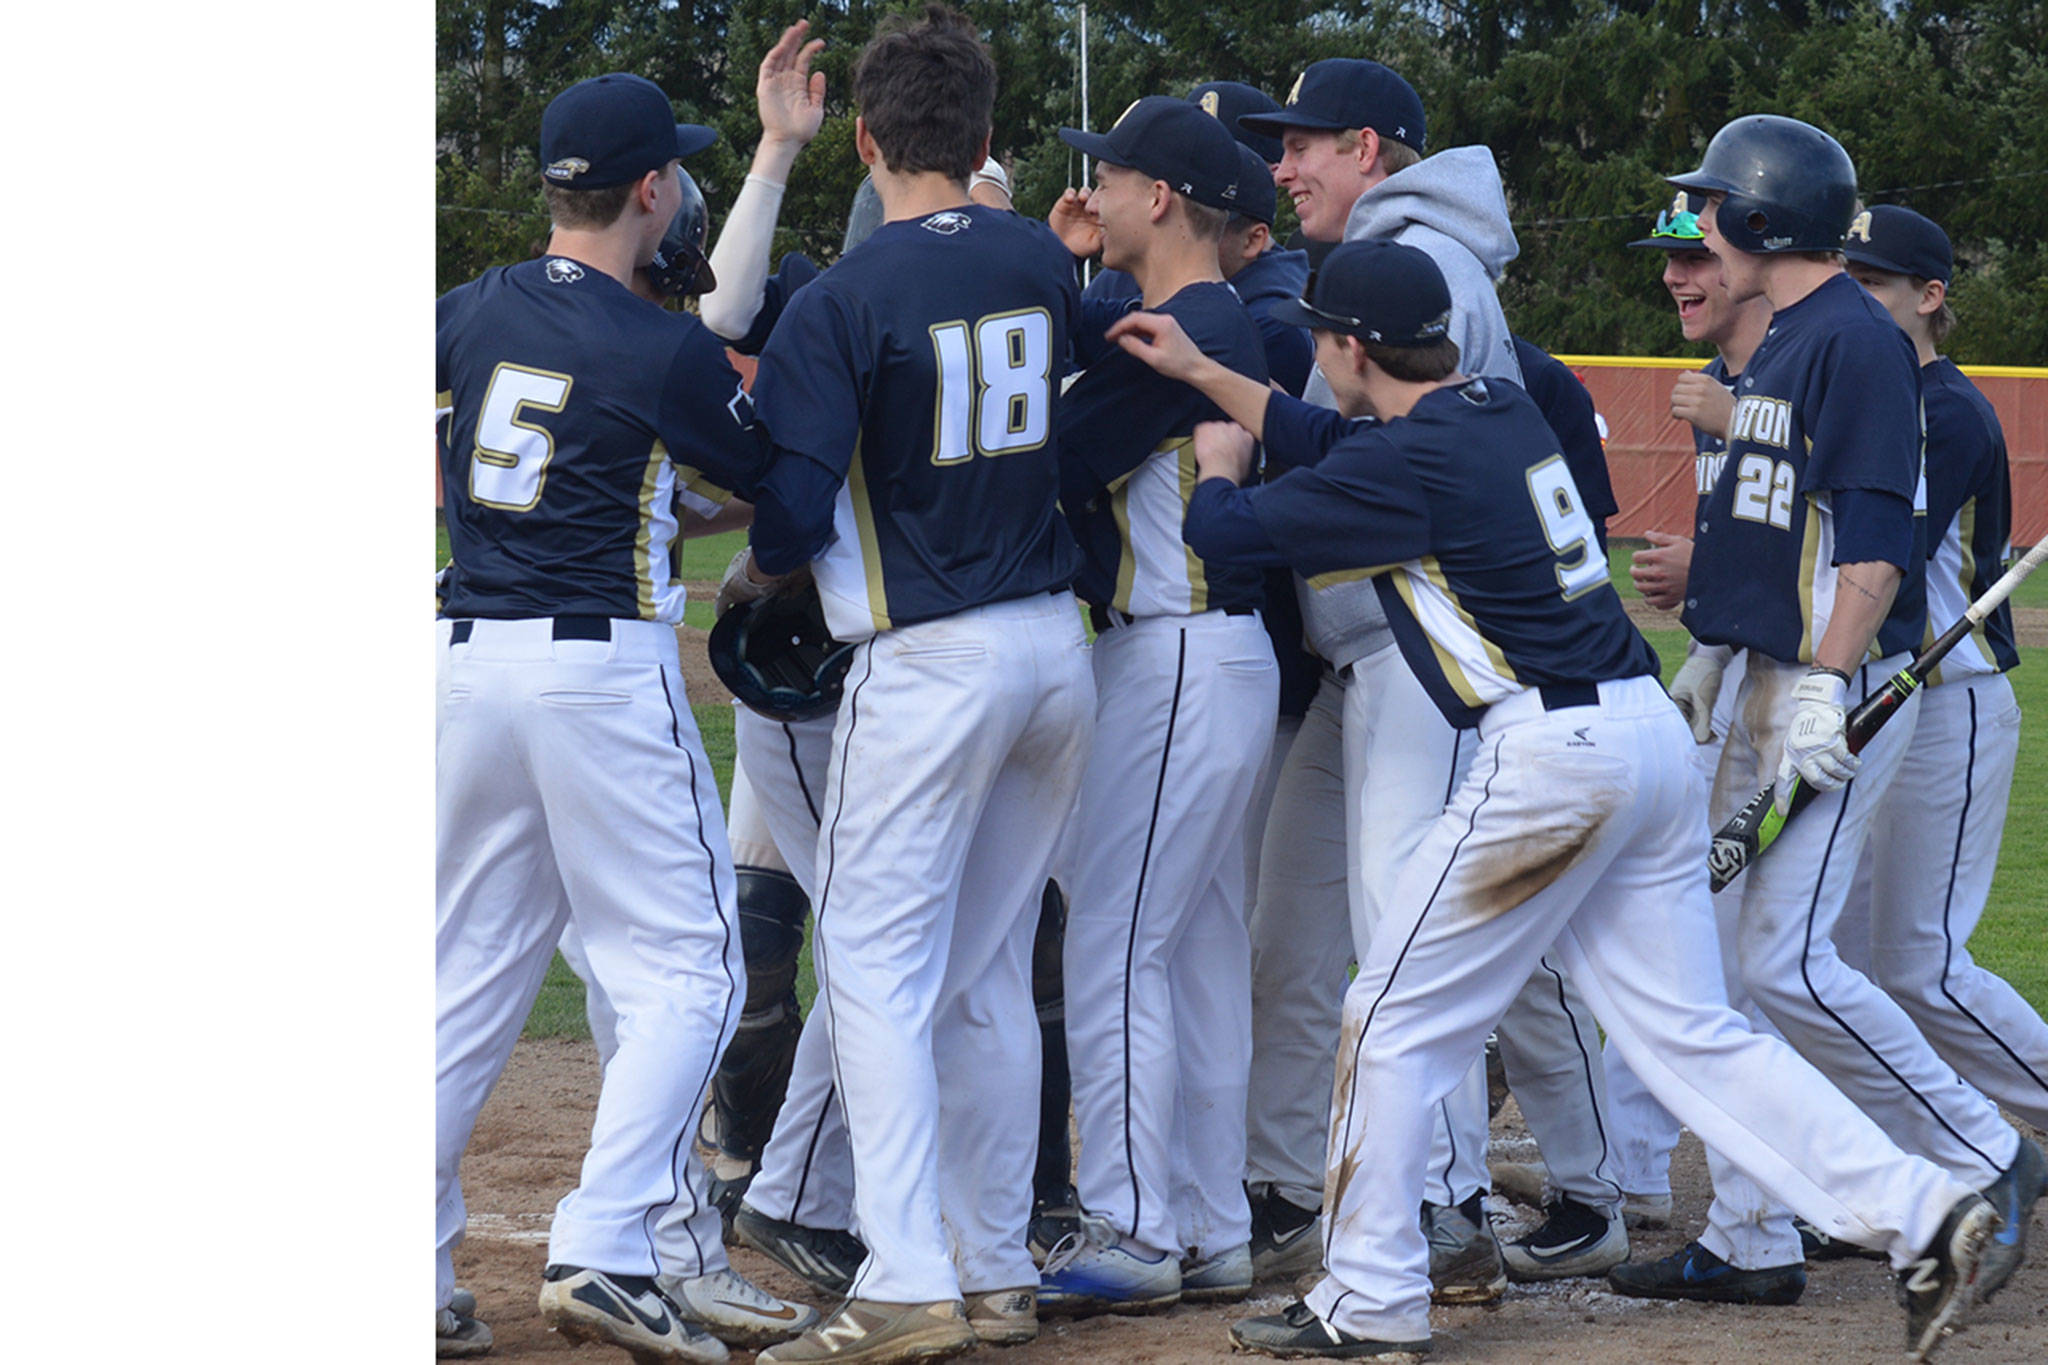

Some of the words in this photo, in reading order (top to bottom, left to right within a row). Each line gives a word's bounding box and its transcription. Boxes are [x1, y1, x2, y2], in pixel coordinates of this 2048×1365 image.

[468, 361, 573, 512] 5
[928, 306, 1053, 467] 18
[1526, 453, 1611, 602] 9
[1732, 453, 1796, 532] 22
